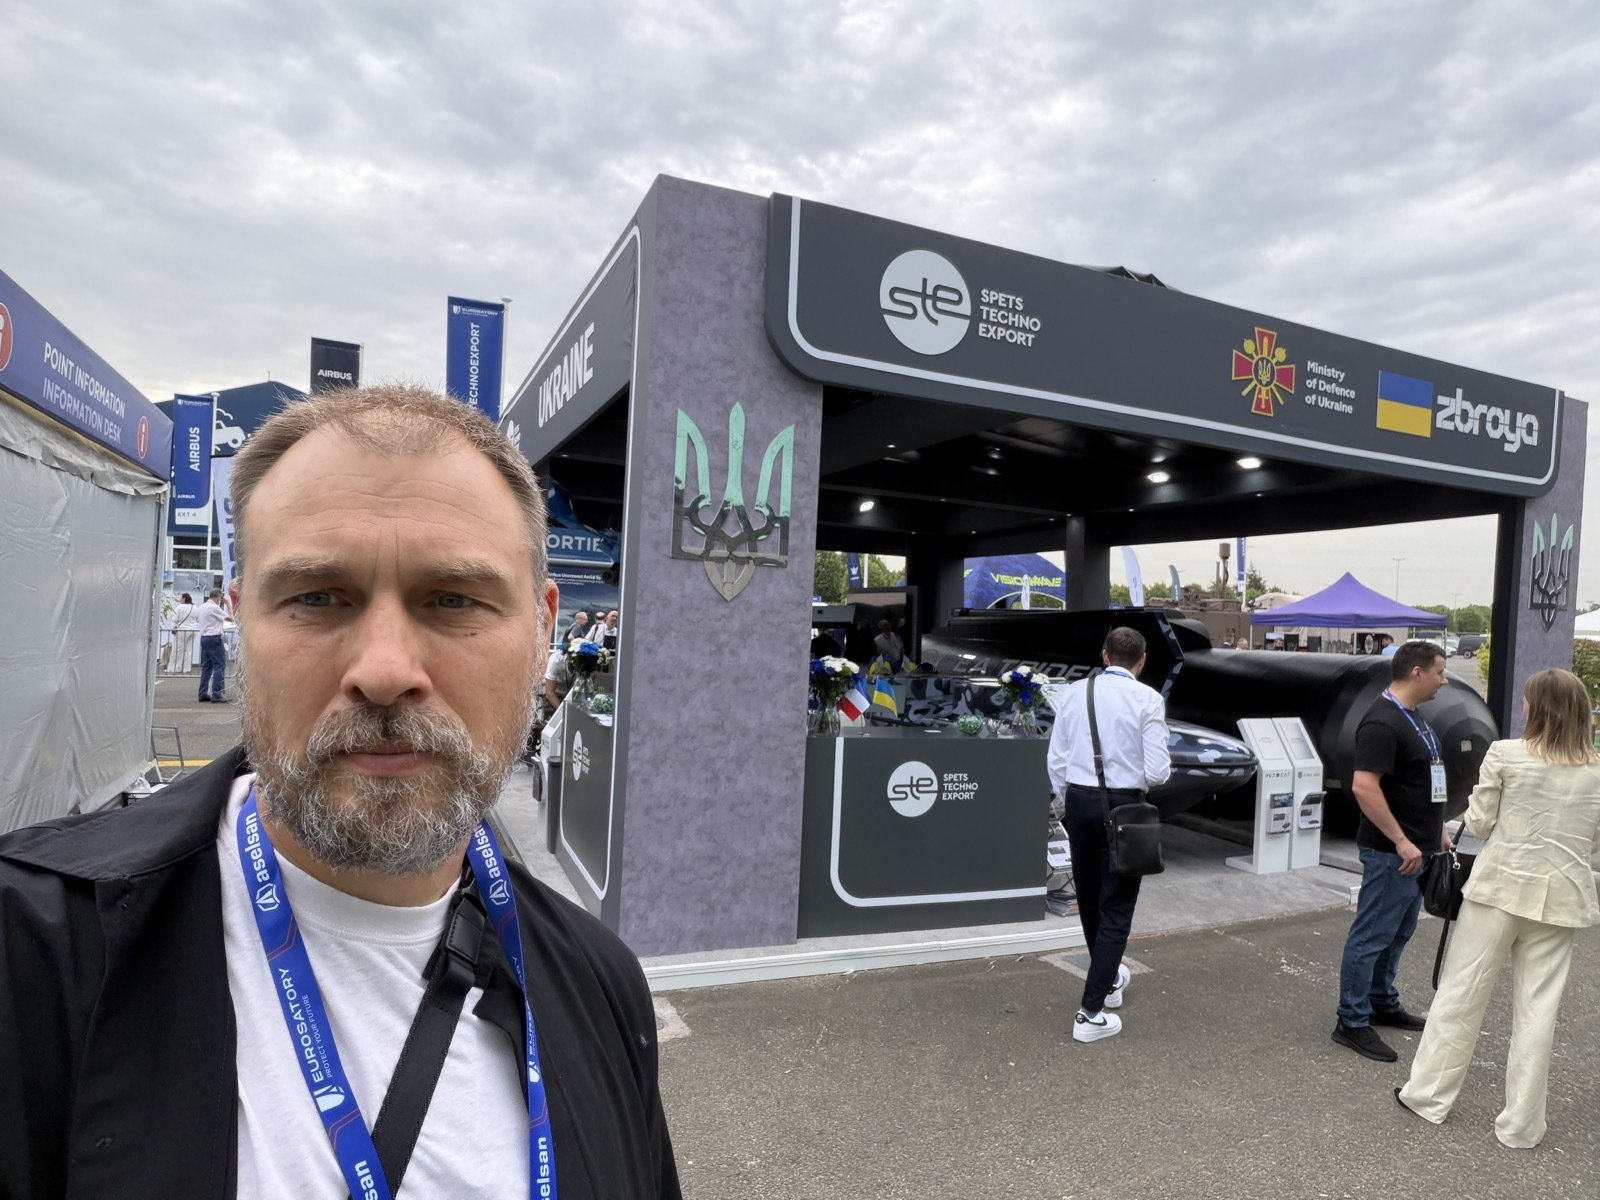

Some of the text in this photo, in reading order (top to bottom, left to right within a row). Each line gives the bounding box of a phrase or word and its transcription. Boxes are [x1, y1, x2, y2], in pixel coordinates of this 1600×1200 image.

[979, 305, 1042, 332] TECHNO
[980, 288, 1025, 311] SPETS
[978, 323, 1035, 347] EXPORT
[43, 341, 126, 419] POINT INFORMATION
[317, 368, 353, 381] AIRBUS
[469, 322, 481, 406] ECHNOEXPORT
[538, 321, 595, 429] UKRAINE
[1307, 360, 1346, 383] Ministry
[1304, 394, 1354, 414] of Ukraine
[1305, 378, 1356, 399] of Defence
[42, 377, 122, 444] INFORMATION DESK
[1435, 387, 1539, 454] zbroya
[188, 426, 201, 472] AIRBUS
[546, 533, 604, 552] ORTIE
[942, 792, 975, 801] EXPORT
[943, 773, 969, 782] SPETS
[943, 782, 979, 791] TECHNO
[244, 812, 271, 883] aselsan
[474, 825, 501, 879] aselsa
[278, 967, 325, 1084] EUROSATORY
[302, 994, 333, 1079] PROTECT YOUR FUTURE
[354, 1160, 379, 1200] san
[536, 1137, 551, 1200] elsan
